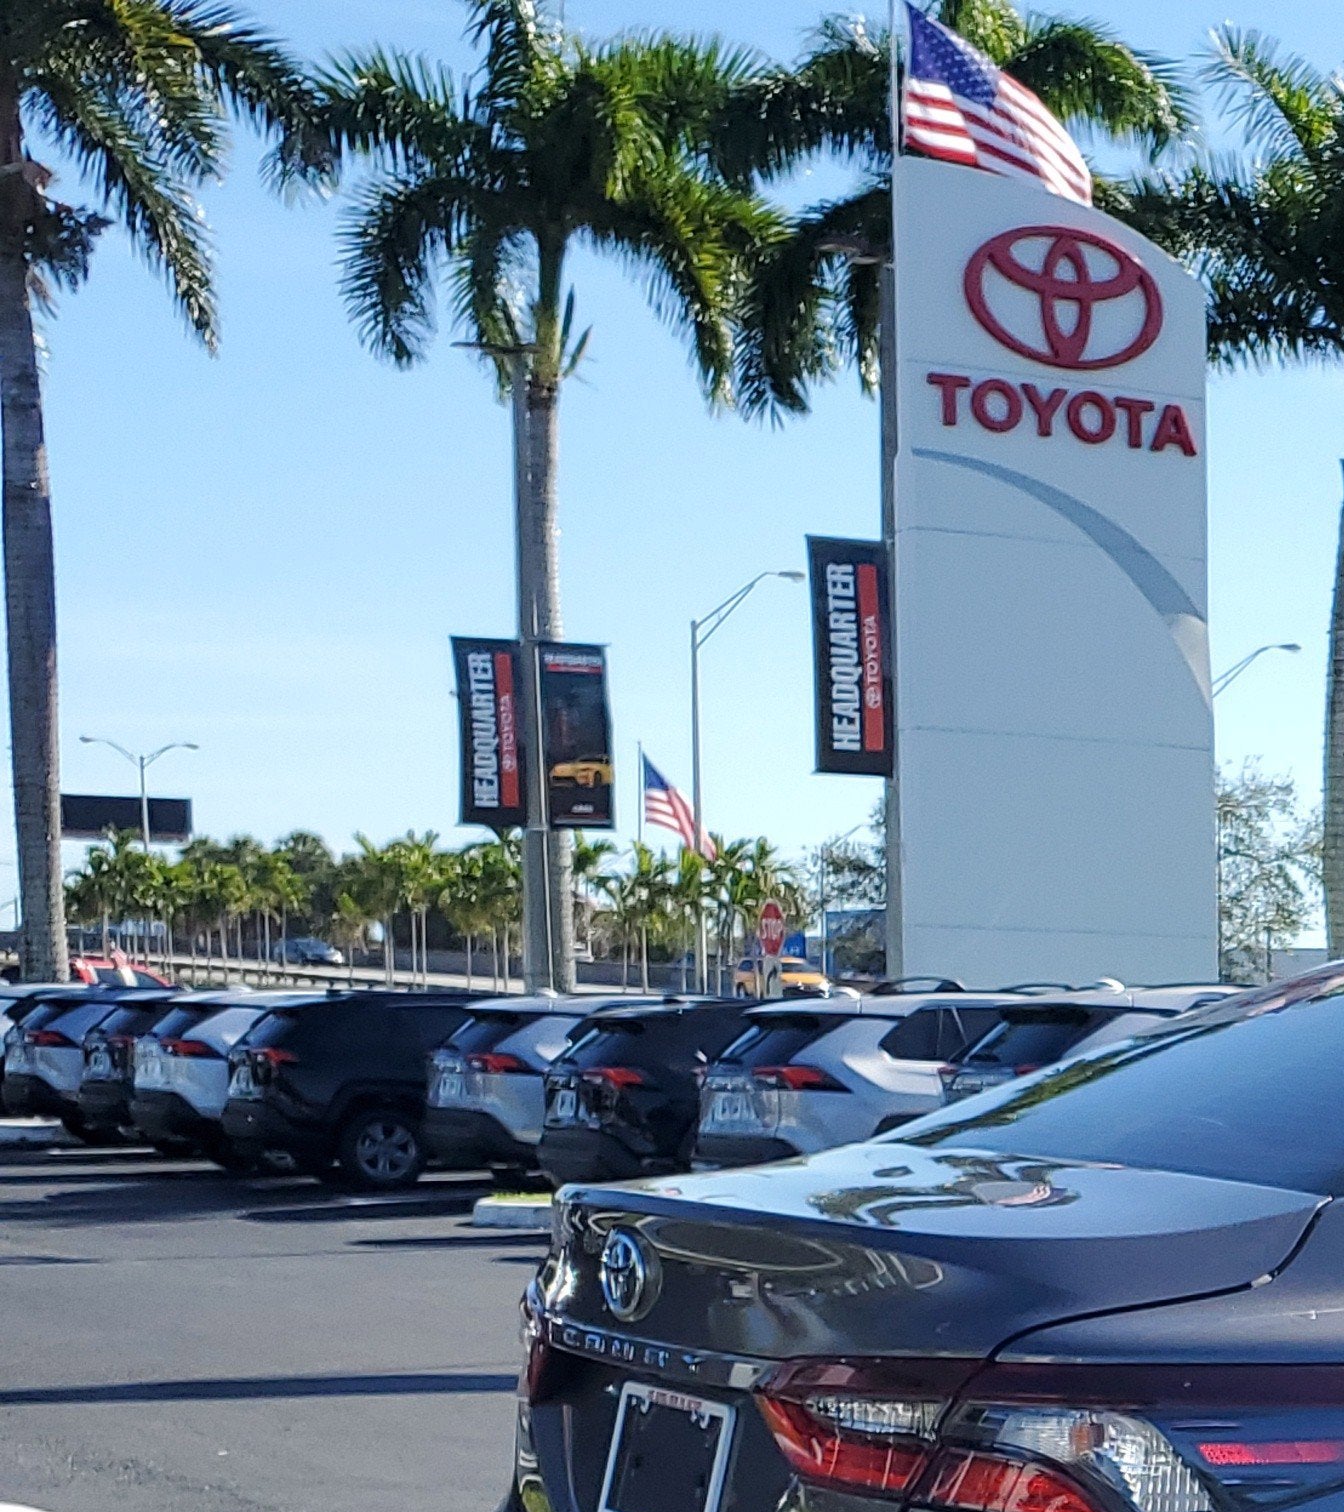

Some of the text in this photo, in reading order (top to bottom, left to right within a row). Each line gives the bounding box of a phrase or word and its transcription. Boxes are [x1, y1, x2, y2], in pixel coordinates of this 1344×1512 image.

[926, 372, 1198, 457] TOYOTA
[825, 563, 863, 751] HEADQUARTER
[863, 615, 881, 686] TOYOTA
[467, 652, 499, 808] HEADQUARTER
[761, 917, 783, 940] STOP
[562, 1327, 705, 1371] CAMRY
